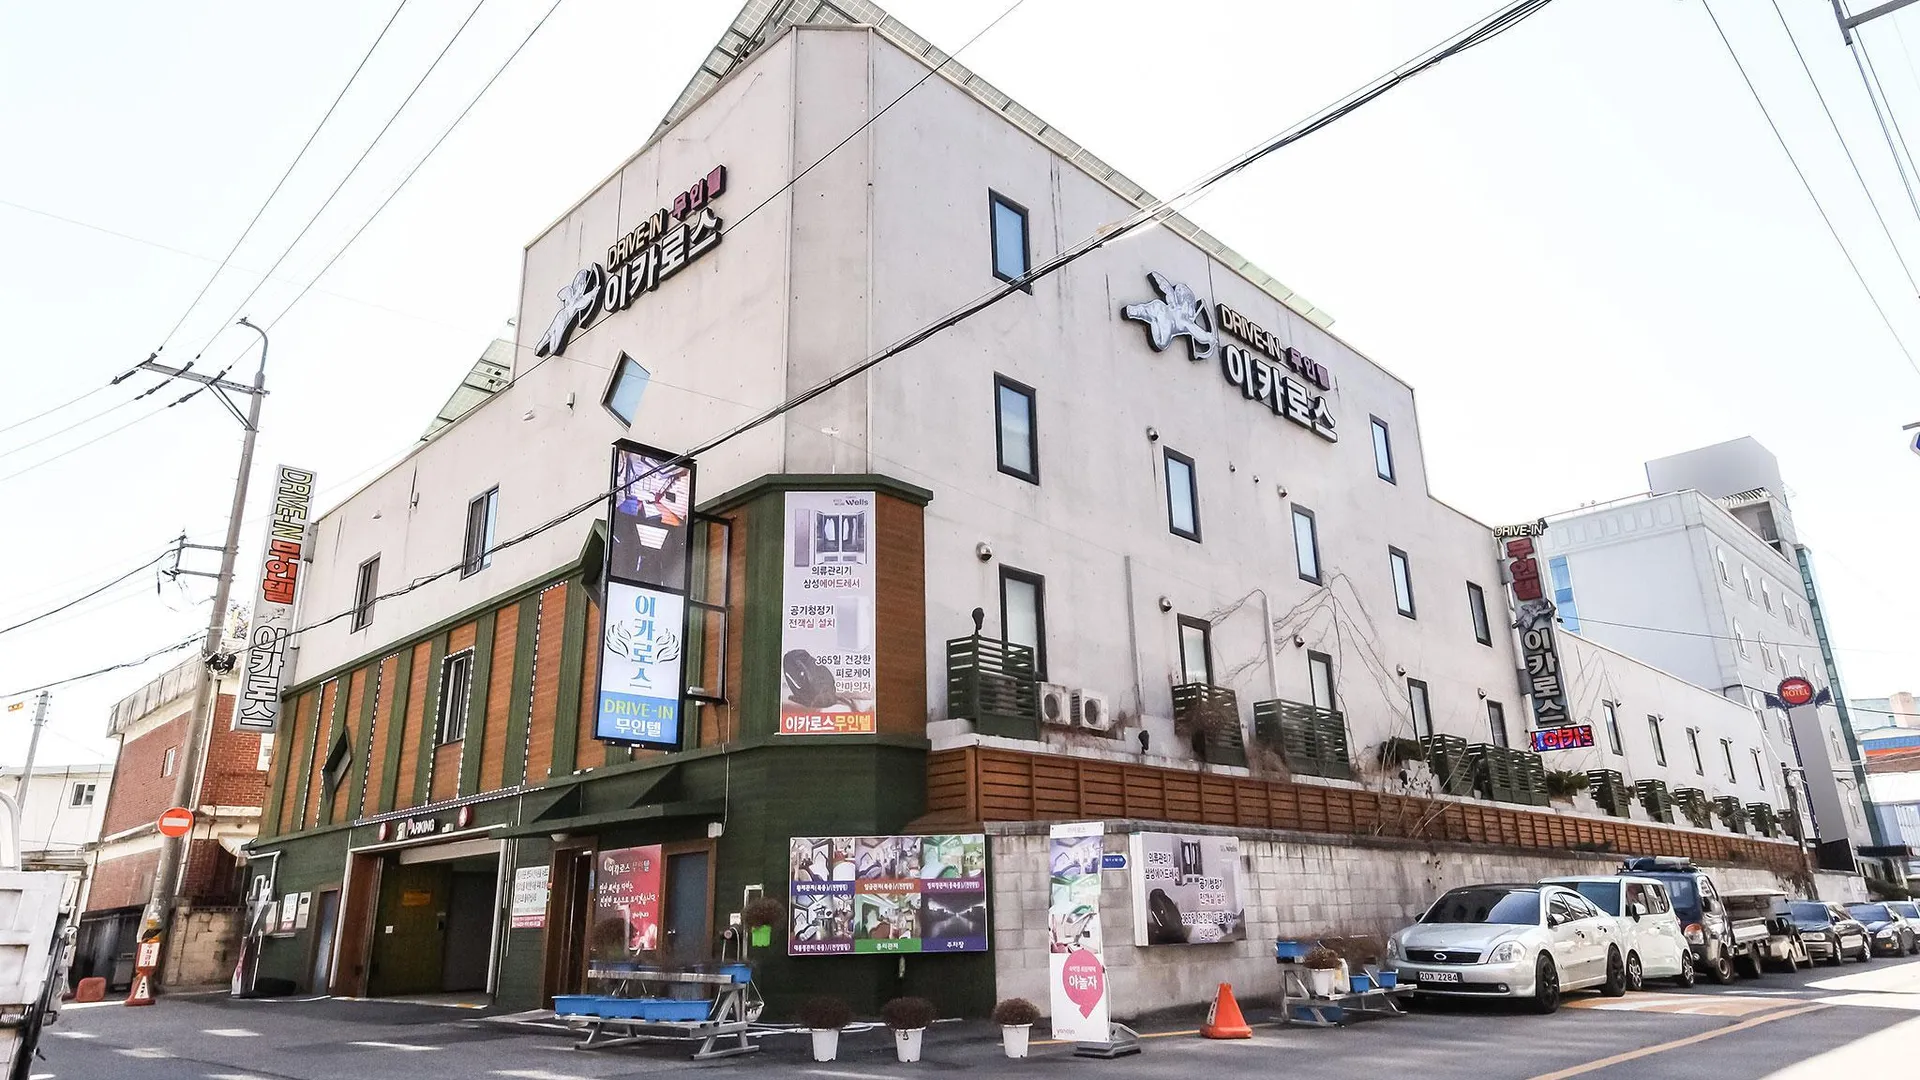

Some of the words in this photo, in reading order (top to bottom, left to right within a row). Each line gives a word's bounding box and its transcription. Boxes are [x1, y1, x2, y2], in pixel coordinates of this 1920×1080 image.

[607, 209, 667, 272] DRIVE-IN
[672, 165, 726, 221] 무인텔
[604, 208, 723, 312] 이카로스
[1217, 304, 1282, 361] DRIVE-IN
[1223, 344, 1338, 443] 이카로스
[271, 467, 313, 540] DRIVE-IN
[1494, 523, 1544, 537] DRIVE-IN
[263, 539, 301, 605] 무인텔
[812, 566, 852, 575] 의류관리기
[803, 579, 860, 589] 삼성에어드레서
[790, 605, 834, 616] 공기청정기
[788, 618, 815, 629] 전객실
[818, 618, 836, 628] 설치
[629, 594, 656, 690] 이카로스
[816, 655, 841, 665] 365일
[845, 654, 871, 665] 건강한
[240, 625, 287, 727] 이카로스
[836, 668, 871, 678] 피로케어
[1523, 627, 1566, 726] 이카로스
[836, 682, 871, 692] 안마의자
[603, 698, 673, 720] DRIVE-IN
[615, 717, 661, 737] 무인텔
[786, 714, 871, 732] 이카로스무인텔
[406, 818, 435, 836] PARKING
[1069, 975, 1097, 990] 야놀자
[1438, 973, 1458, 981] 2284
